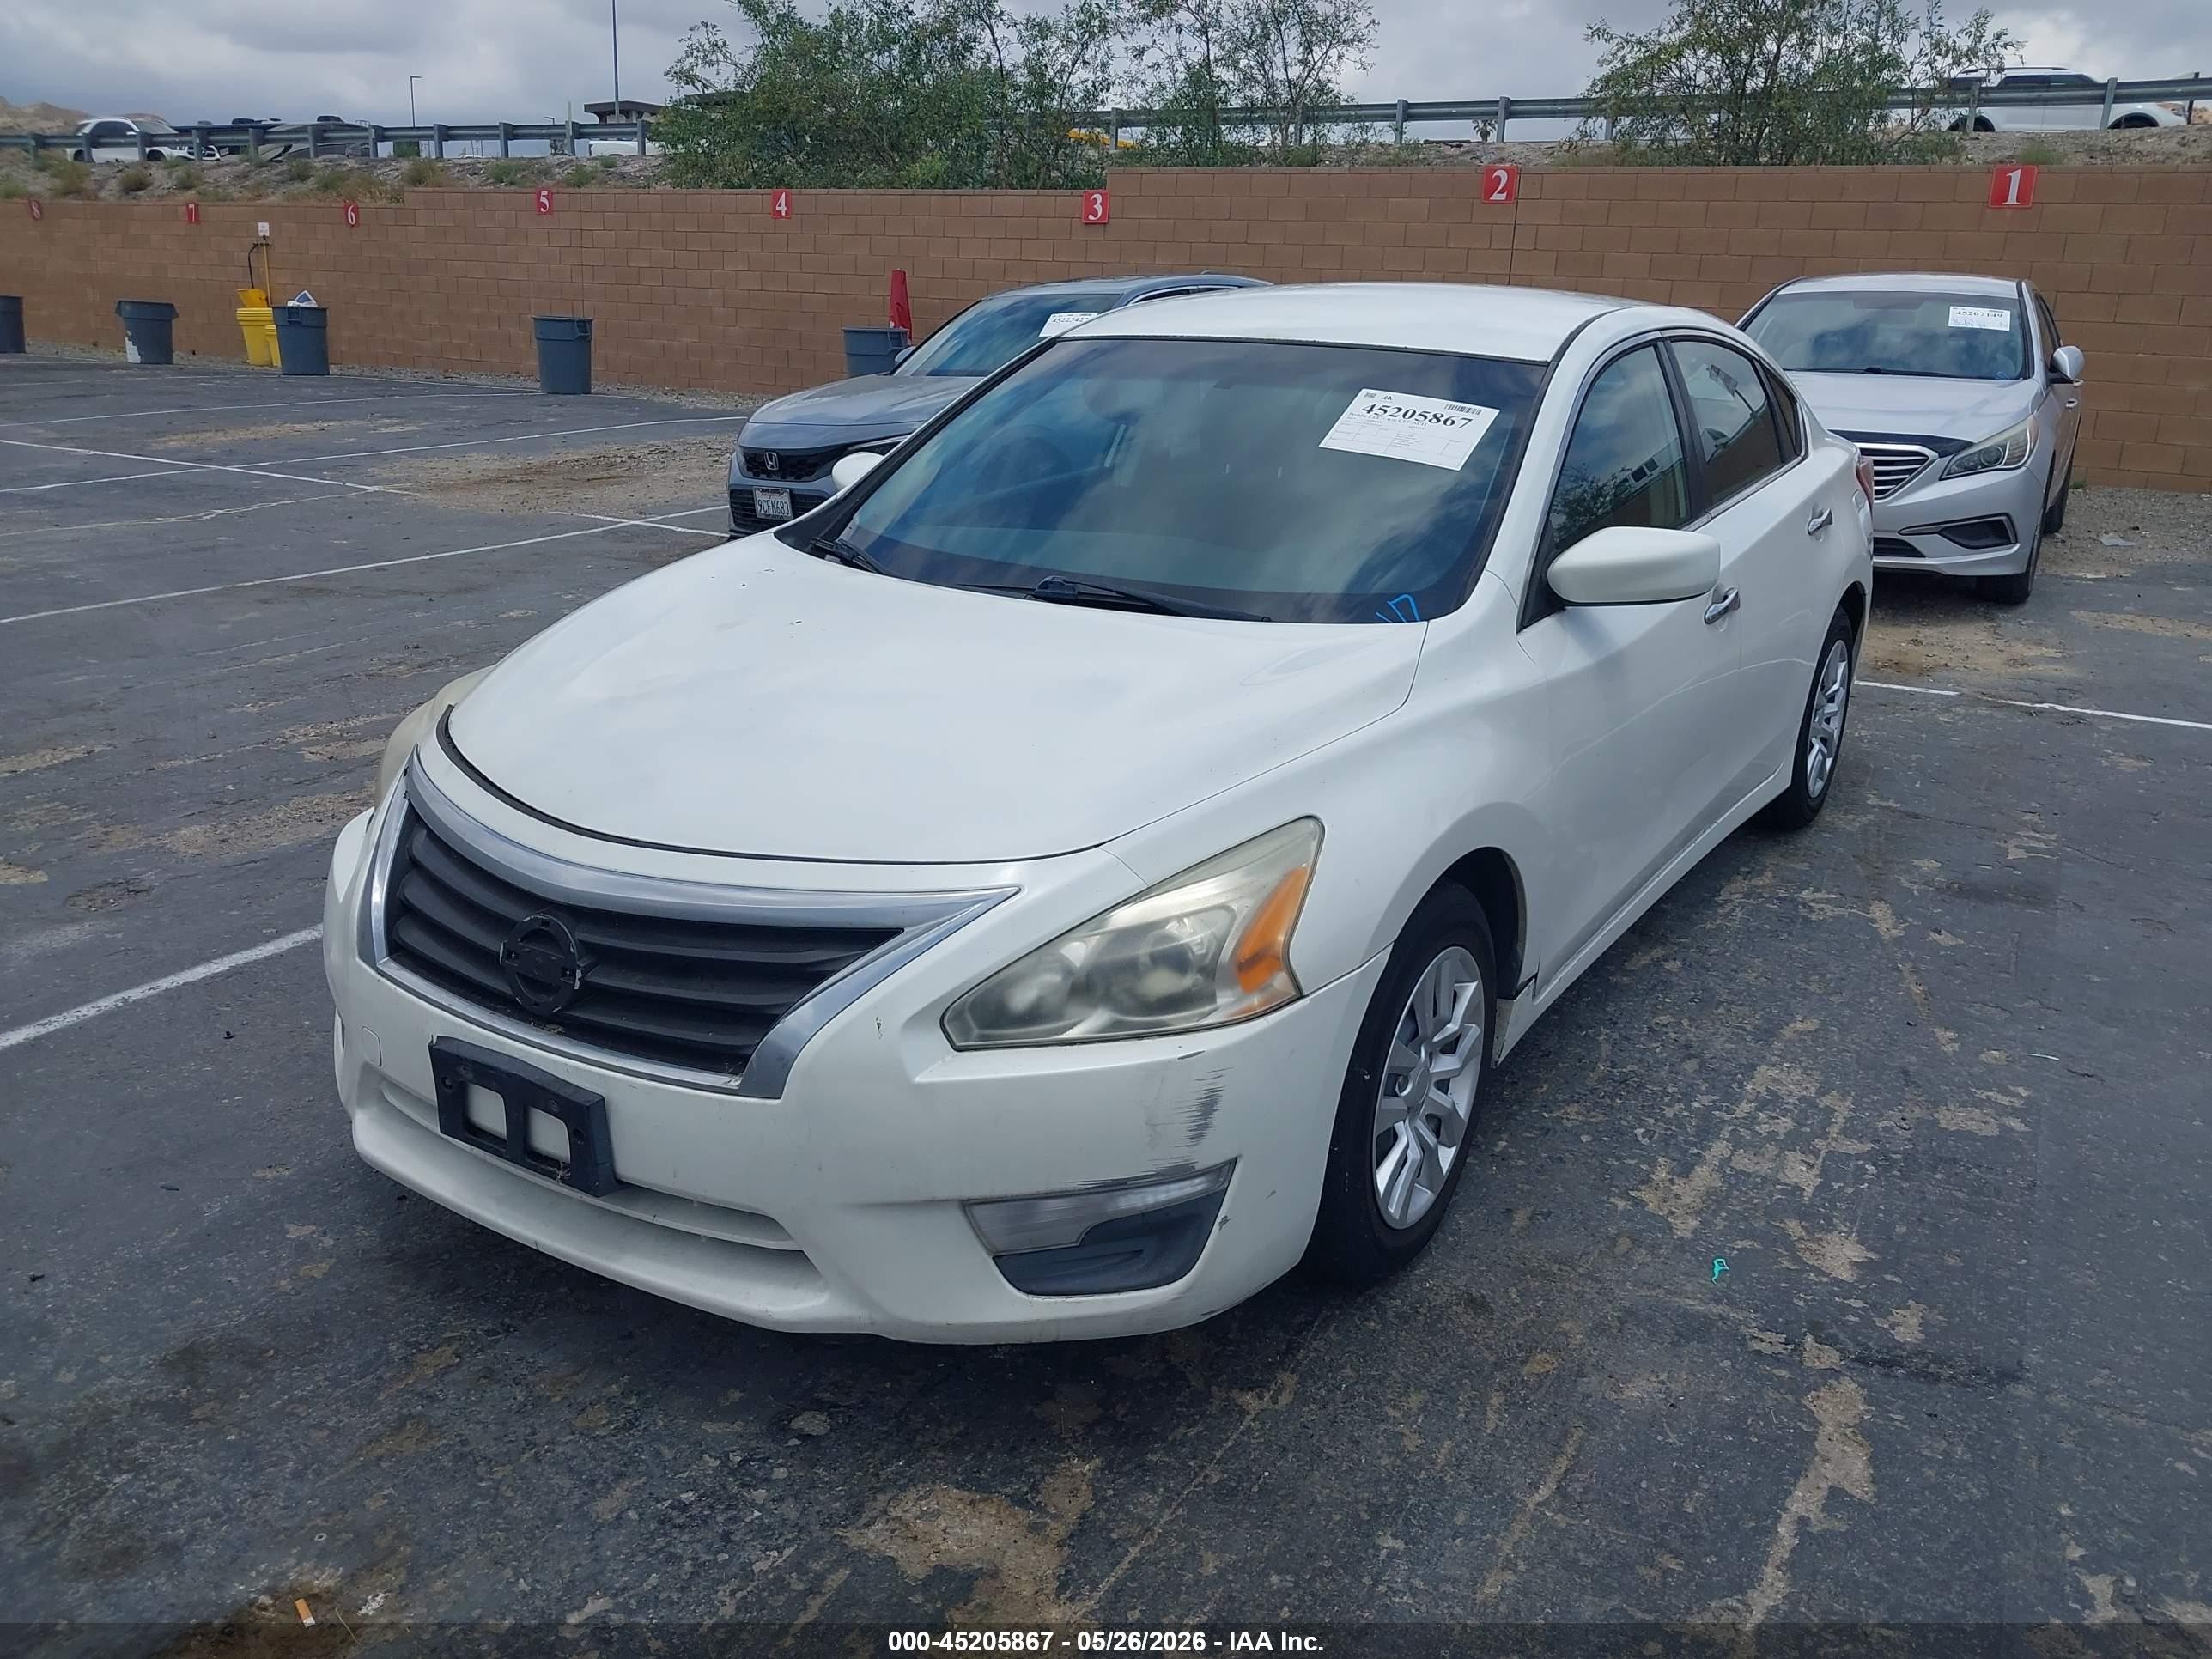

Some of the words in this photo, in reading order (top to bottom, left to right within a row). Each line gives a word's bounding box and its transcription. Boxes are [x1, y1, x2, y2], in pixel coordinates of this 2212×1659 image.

[1489, 169, 1508, 201] 2
[2002, 168, 2021, 205] 1
[188, 203, 195, 222] 7
[539, 190, 550, 213] 5
[775, 191, 787, 216] 4
[1088, 193, 1103, 221] 3
[347, 204, 356, 225] 6
[1360, 403, 1474, 429] 45205867
